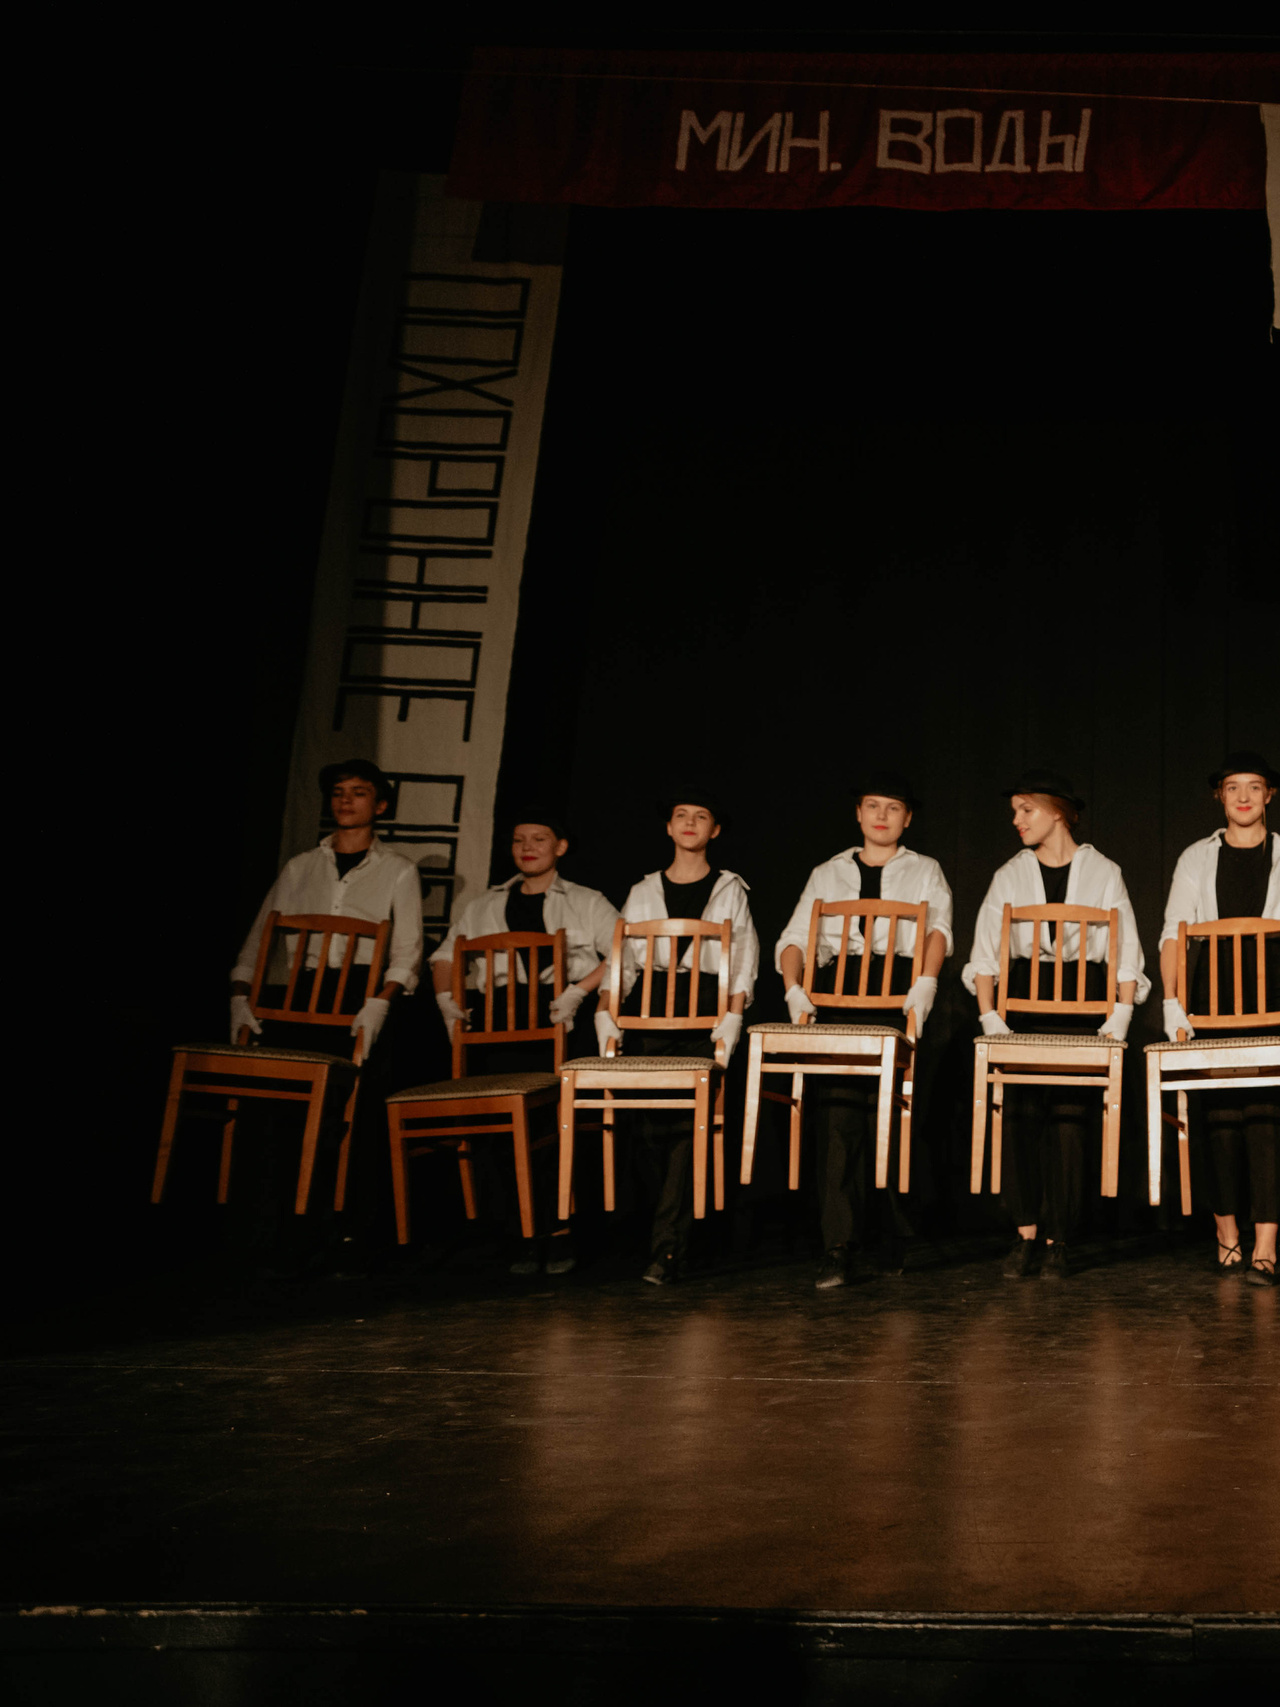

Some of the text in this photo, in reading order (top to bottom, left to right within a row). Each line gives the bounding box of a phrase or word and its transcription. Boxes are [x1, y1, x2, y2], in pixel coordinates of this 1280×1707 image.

[675, 108, 1092, 175] МИН. ВОДЫ
[332, 272, 531, 742] ПОХОРОННОЕ
